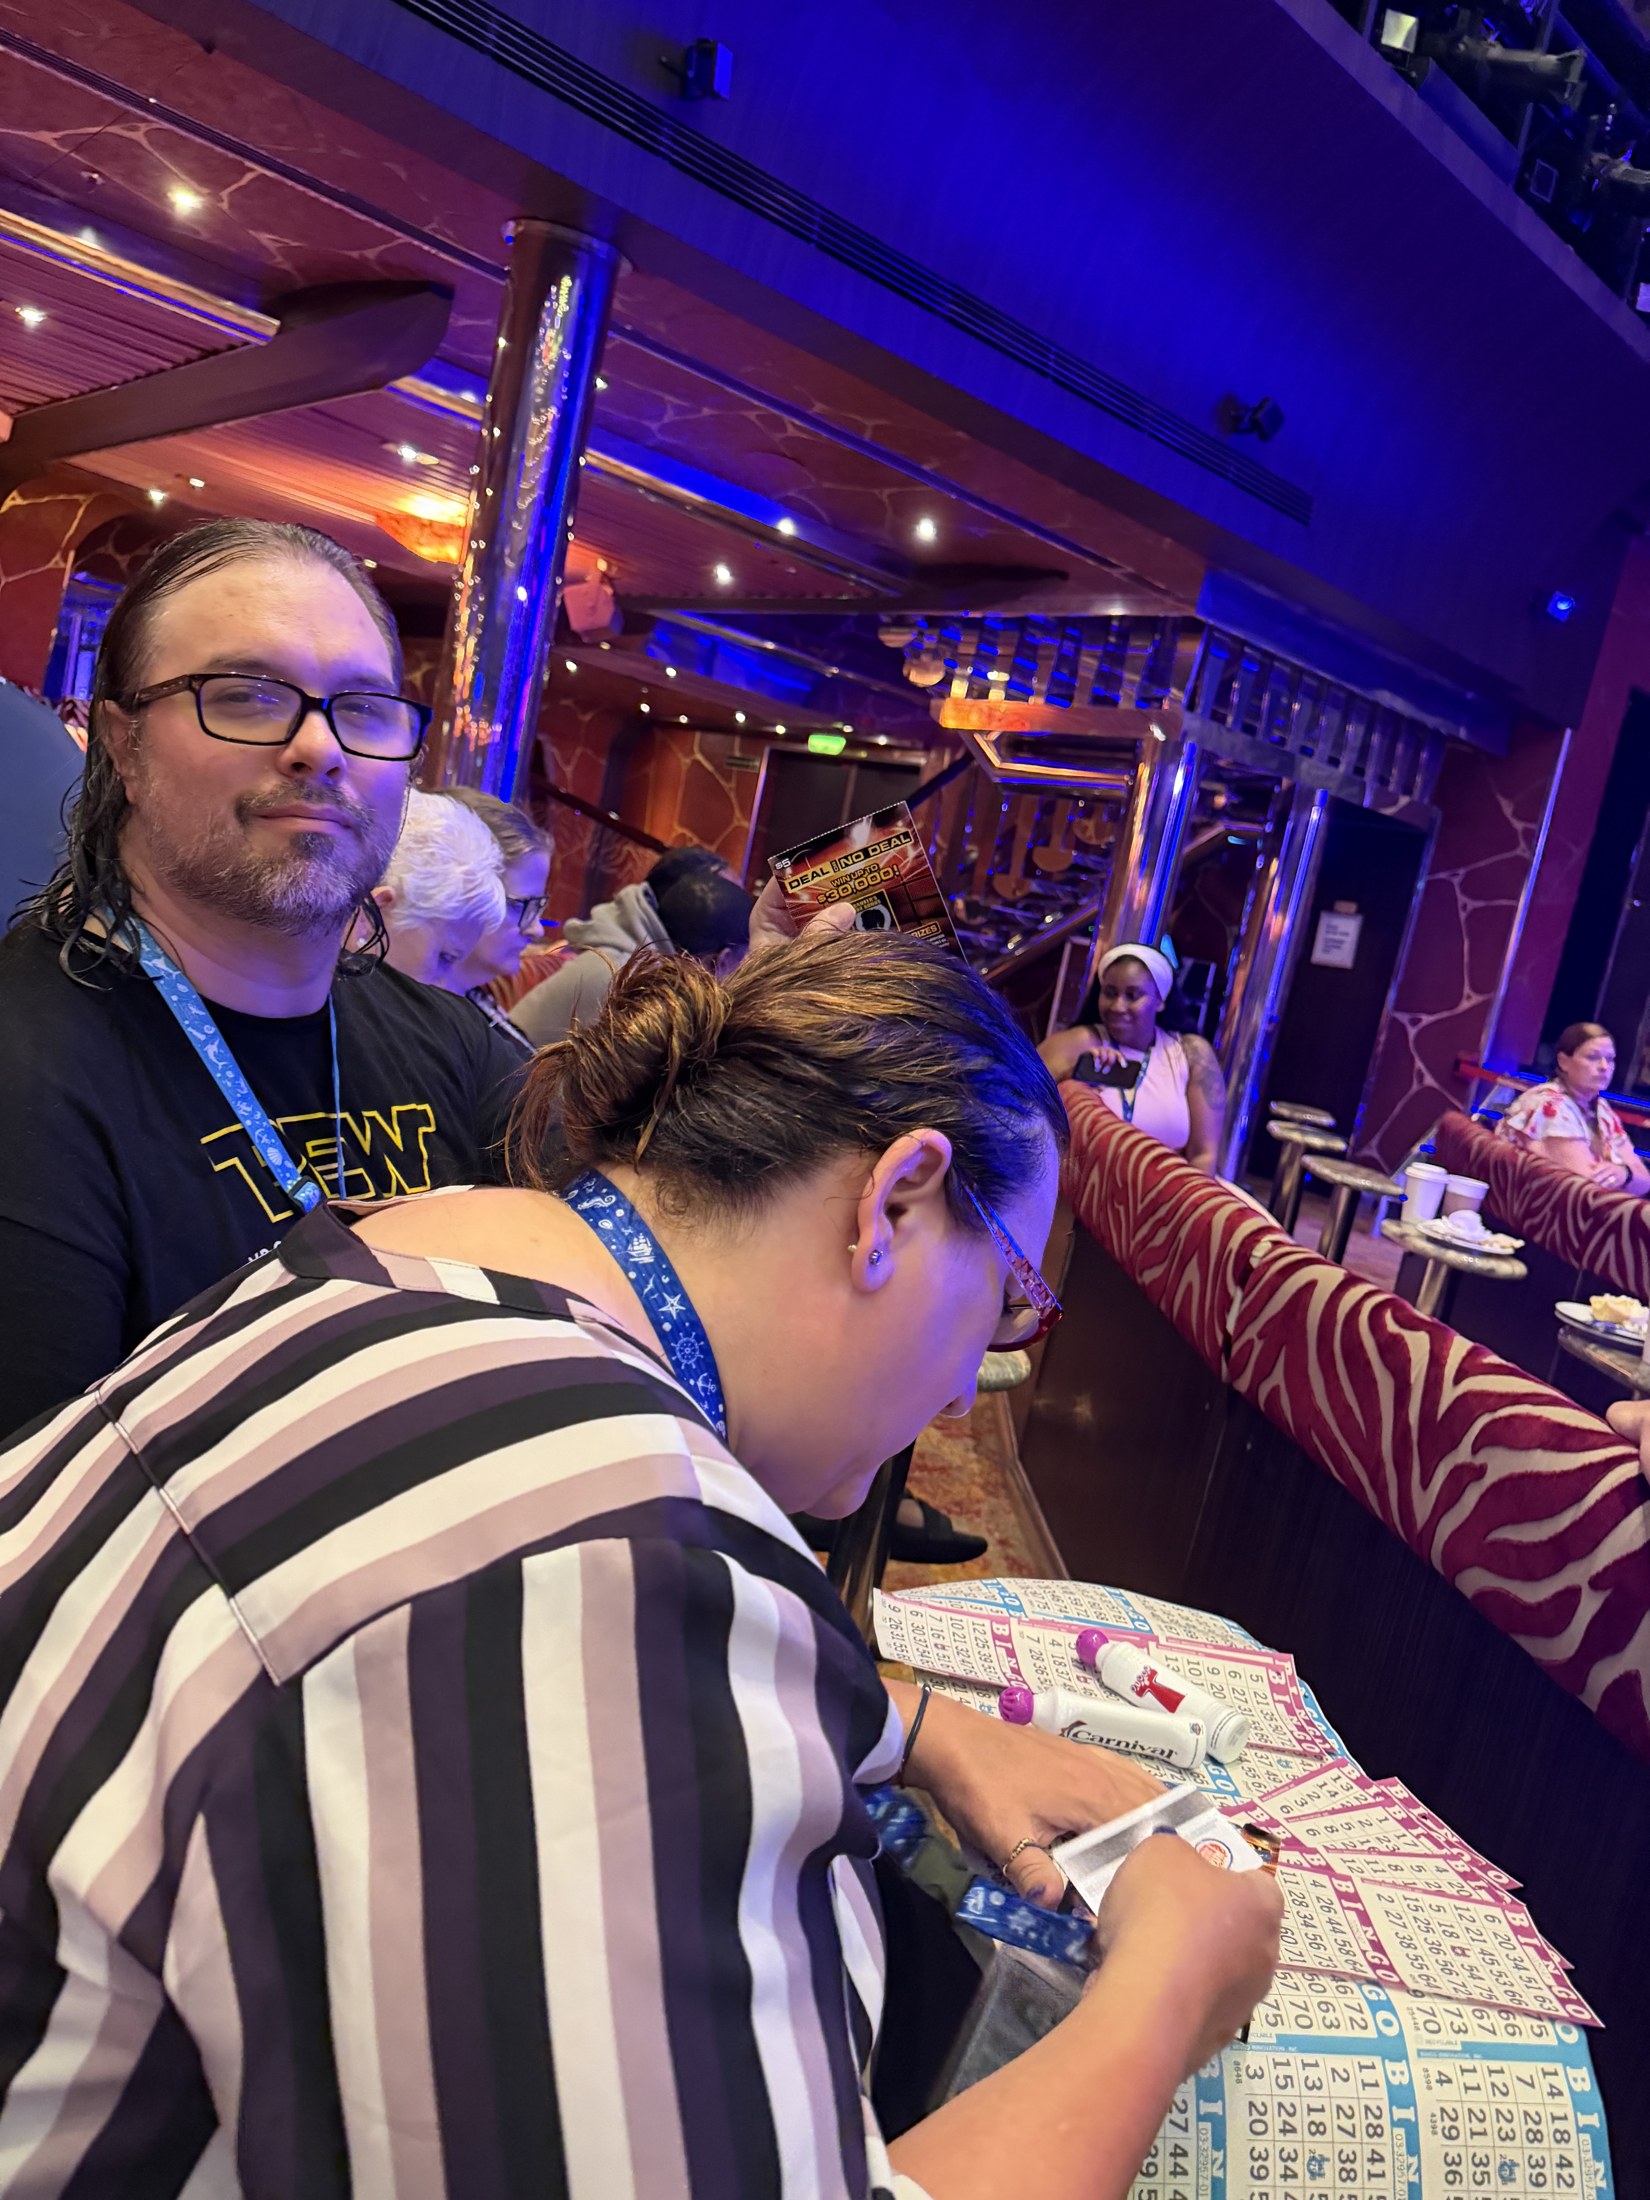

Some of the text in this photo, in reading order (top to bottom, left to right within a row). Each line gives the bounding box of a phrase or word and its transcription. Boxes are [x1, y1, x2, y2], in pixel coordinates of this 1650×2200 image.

[775, 858, 791, 870] $5
[788, 867, 830, 891] DEAL
[840, 852, 864, 867] NO
[869, 834, 911, 855] DEAL
[831, 864, 879, 888] WIN UP TO
[817, 864, 900, 904] $30,000!
[911, 925, 938, 938] RIZES
[888, 1604, 901, 1613] 9
[888, 1617, 902, 1630] 26
[950, 1617, 963, 1630] 10
[910, 1610, 928, 1650] 6 30 37
[929, 1614, 945, 1641] 7 16
[952, 1632, 966, 1646] 21
[972, 1621, 986, 1636] 12
[974, 1637, 989, 1653] 25
[992, 1621, 1029, 1690] BINGO
[1026, 1635, 1047, 1675] 7 28 36
[1049, 1639, 1071, 1683] 4 18 37
[1187, 1659, 1202, 1676] 10
[1207, 1666, 1226, 1699] 9 20
[930, 1679, 946, 1691] 30
[1228, 1670, 1248, 1704] 6 27
[1250, 1673, 1278, 1724] 5 21 35
[1268, 1669, 1320, 1753] BINGO
[1073, 1729, 1176, 1760] Carnival
[1254, 1752, 1273, 1768] 37
[1190, 1772, 1209, 1785] 65
[1316, 1781, 1339, 1798] 14
[1330, 1774, 1353, 1792] 13
[1280, 1804, 1294, 1814] 6
[1294, 1798, 1309, 1807] 3
[1306, 1791, 1321, 1801] 2
[1306, 1828, 1321, 1837] 6
[1324, 1825, 1339, 1834] 8
[1340, 1822, 1356, 1831] 5
[1358, 1819, 1400, 1852] 2 23
[1376, 1816, 1419, 1848] 1 17
[1342, 1859, 1364, 1874] 12
[1364, 1859, 1386, 1875] 11
[1388, 1863, 1404, 1872] 8
[1410, 1865, 1426, 1873] 5
[1434, 1865, 1473, 1898] 4 20
[1280, 1870, 1327, 1952] 11 28 34 56
[1376, 1892, 1396, 1904] 2
[1310, 1879, 1357, 1958] 4 26 44 58
[1331, 1877, 1400, 1982] BINGO
[1385, 1909, 1408, 1930] 27
[1280, 1927, 1298, 1946] 60
[1394, 1931, 1417, 1950] 38
[1402, 1894, 1472, 1998] 15 25 36 56 72
[1429, 1903, 1500, 2001] 5 18 54 75
[1405, 1952, 1429, 1971] 55
[1453, 1904, 1529, 2008] 12 21 45 53 66
[1484, 1914, 1559, 2013] 6 20 34 51 63
[1504, 1910, 1593, 2021] BINGO
[1417, 1973, 1441, 1991] 64
[1262, 1999, 1285, 2028] 75
[1275, 1971, 1313, 2030] 57 70
[1301, 1972, 1341, 2030] 50 63
[1343, 2002, 1368, 2031] 72
[1415, 2006, 1441, 2035] 70
[1443, 2007, 1468, 2035] 73
[1471, 2008, 1497, 2037] 67
[1497, 2009, 1523, 2038] 66
[1301, 2058, 1323, 2091] 13
[1487, 2066, 1509, 2098] 12
[1422, 2067, 1439, 2136] 8598 4398
[1199, 2058, 1224, 2178] BIN
[1245, 2064, 1270, 2181] 3 20 39
[1272, 2057, 1298, 2182] 15 24 34
[1307, 2104, 1327, 2137] 18
[1331, 2067, 1357, 2183] 2 27 38
[1357, 2061, 1386, 2182] 11 28 41
[1385, 2059, 1419, 2183] BIN
[1436, 2070, 1463, 2186] 4 29 36
[1459, 2064, 1491, 2187] 11 21 35
[1495, 2108, 1516, 2143] 23
[1515, 2074, 1547, 2188] 7 28 39
[1541, 2067, 1575, 2188] 14 18 42
[1566, 2066, 1607, 2189] BIN
[1169, 2099, 1189, 2179] 27 44
